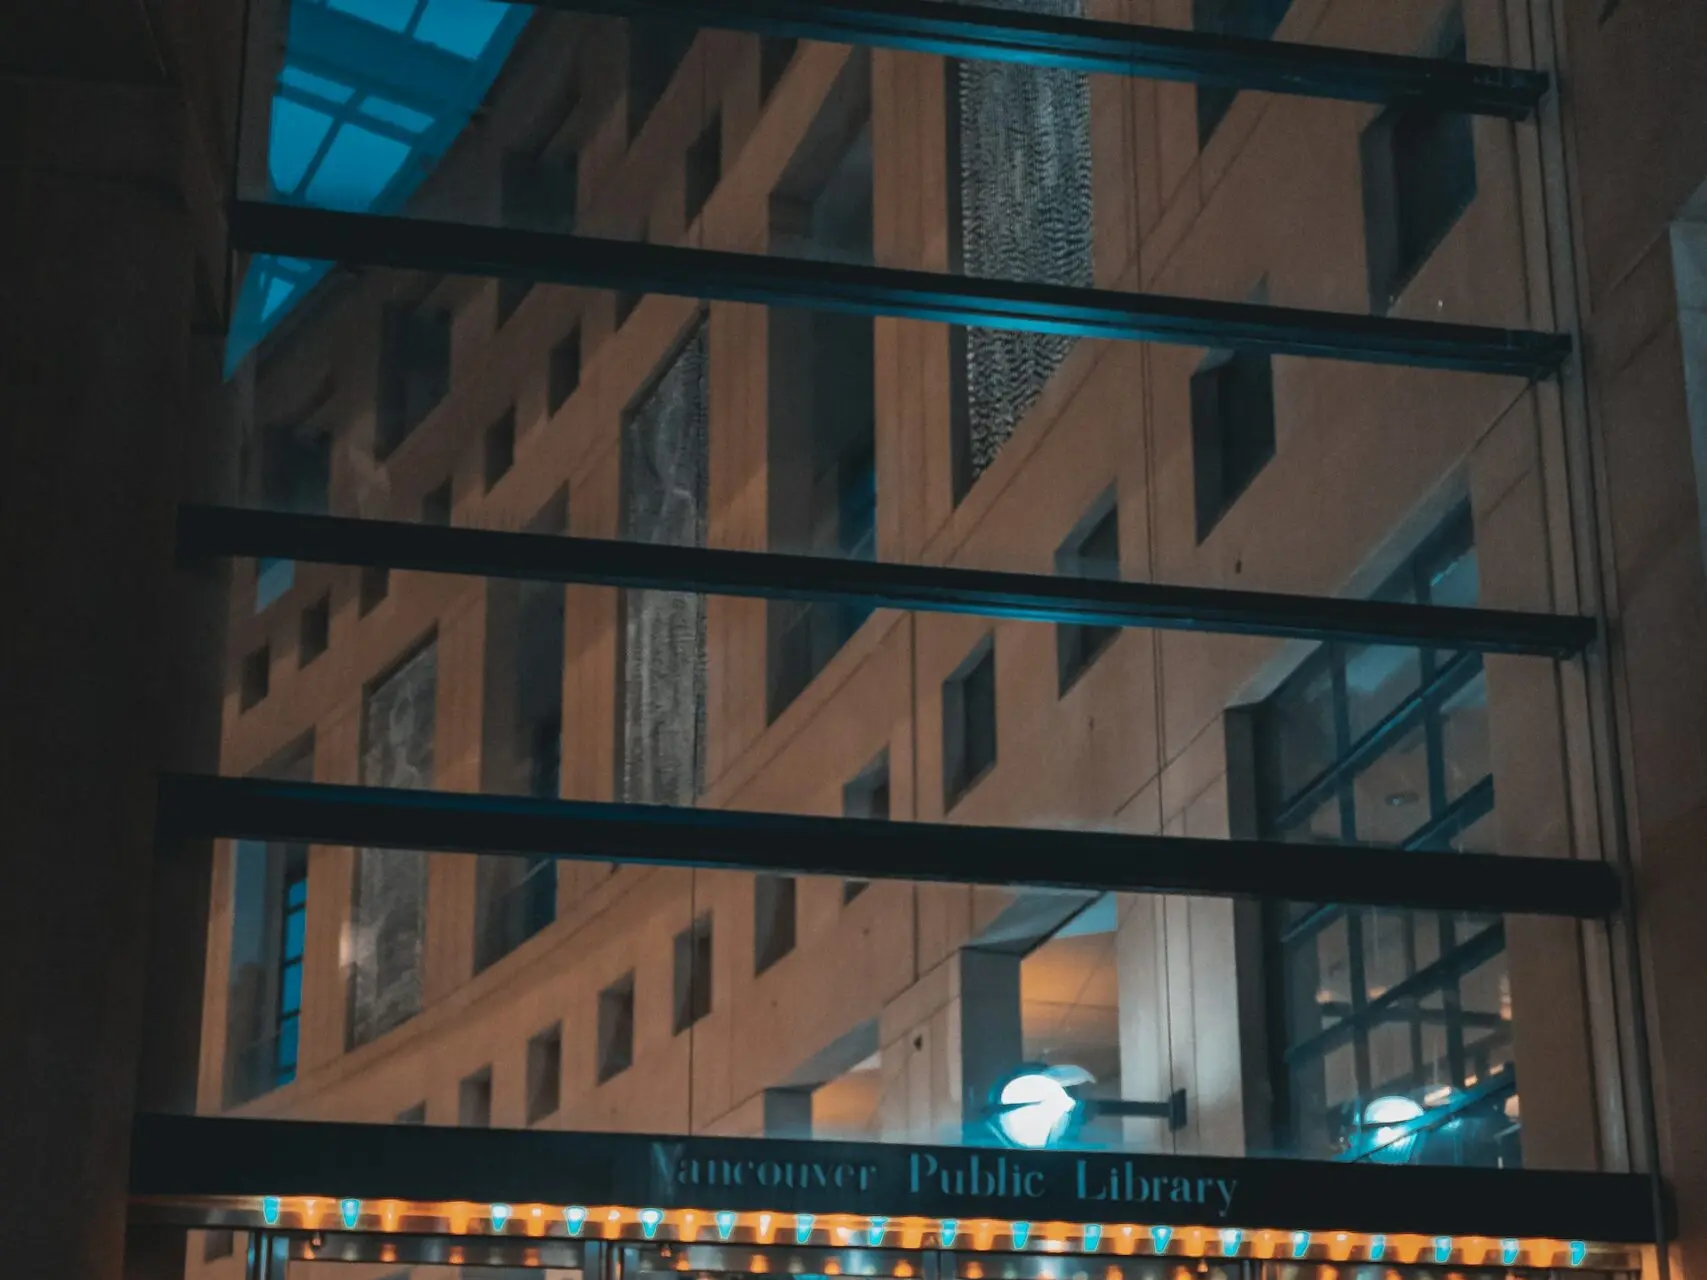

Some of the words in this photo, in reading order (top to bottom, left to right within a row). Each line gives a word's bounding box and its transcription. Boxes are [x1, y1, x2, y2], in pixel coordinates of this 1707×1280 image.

[650, 1142, 877, 1192] Vancouver
[908, 1151, 1045, 1197] Public
[1075, 1158, 1238, 1217] Library
